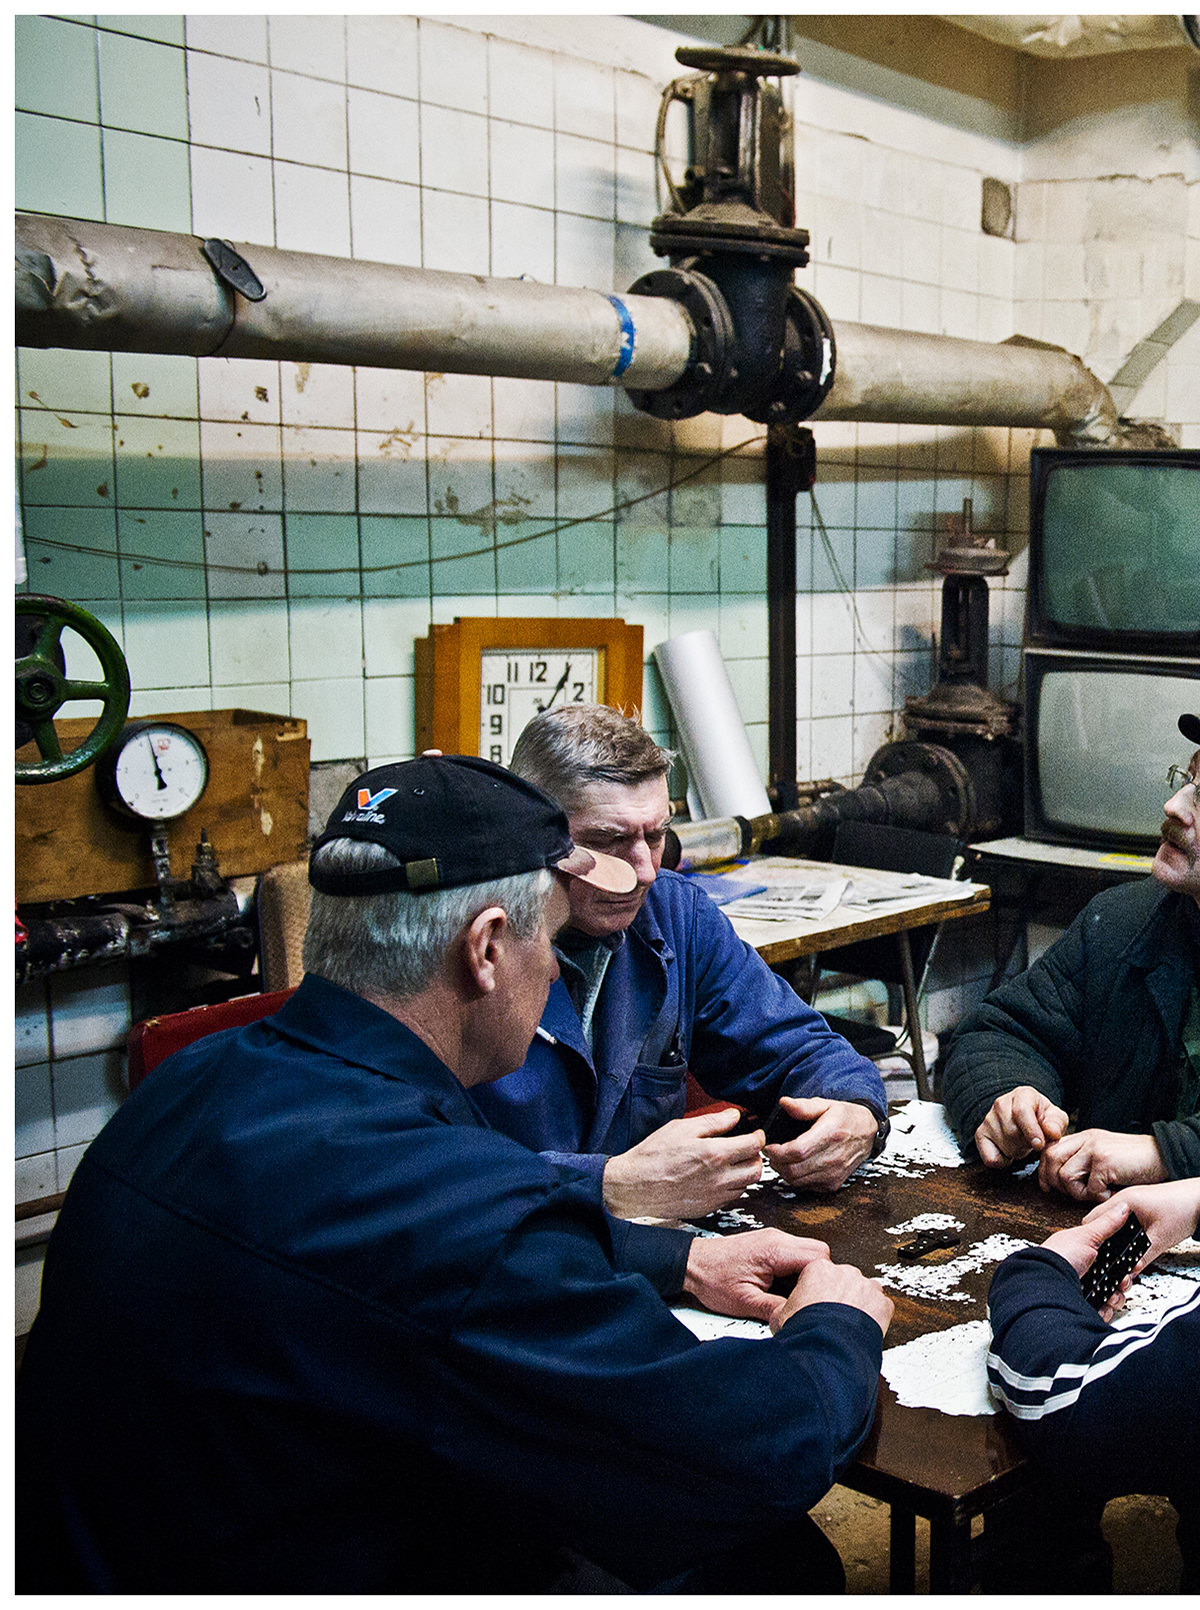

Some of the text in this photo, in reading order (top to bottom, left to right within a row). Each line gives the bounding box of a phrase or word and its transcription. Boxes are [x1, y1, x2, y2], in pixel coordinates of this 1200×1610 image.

[507, 662, 518, 682] 11
[529, 662, 547, 682] 12
[487, 684, 505, 705] 10
[573, 682, 584, 702] 2
[490, 714, 502, 735] 9
